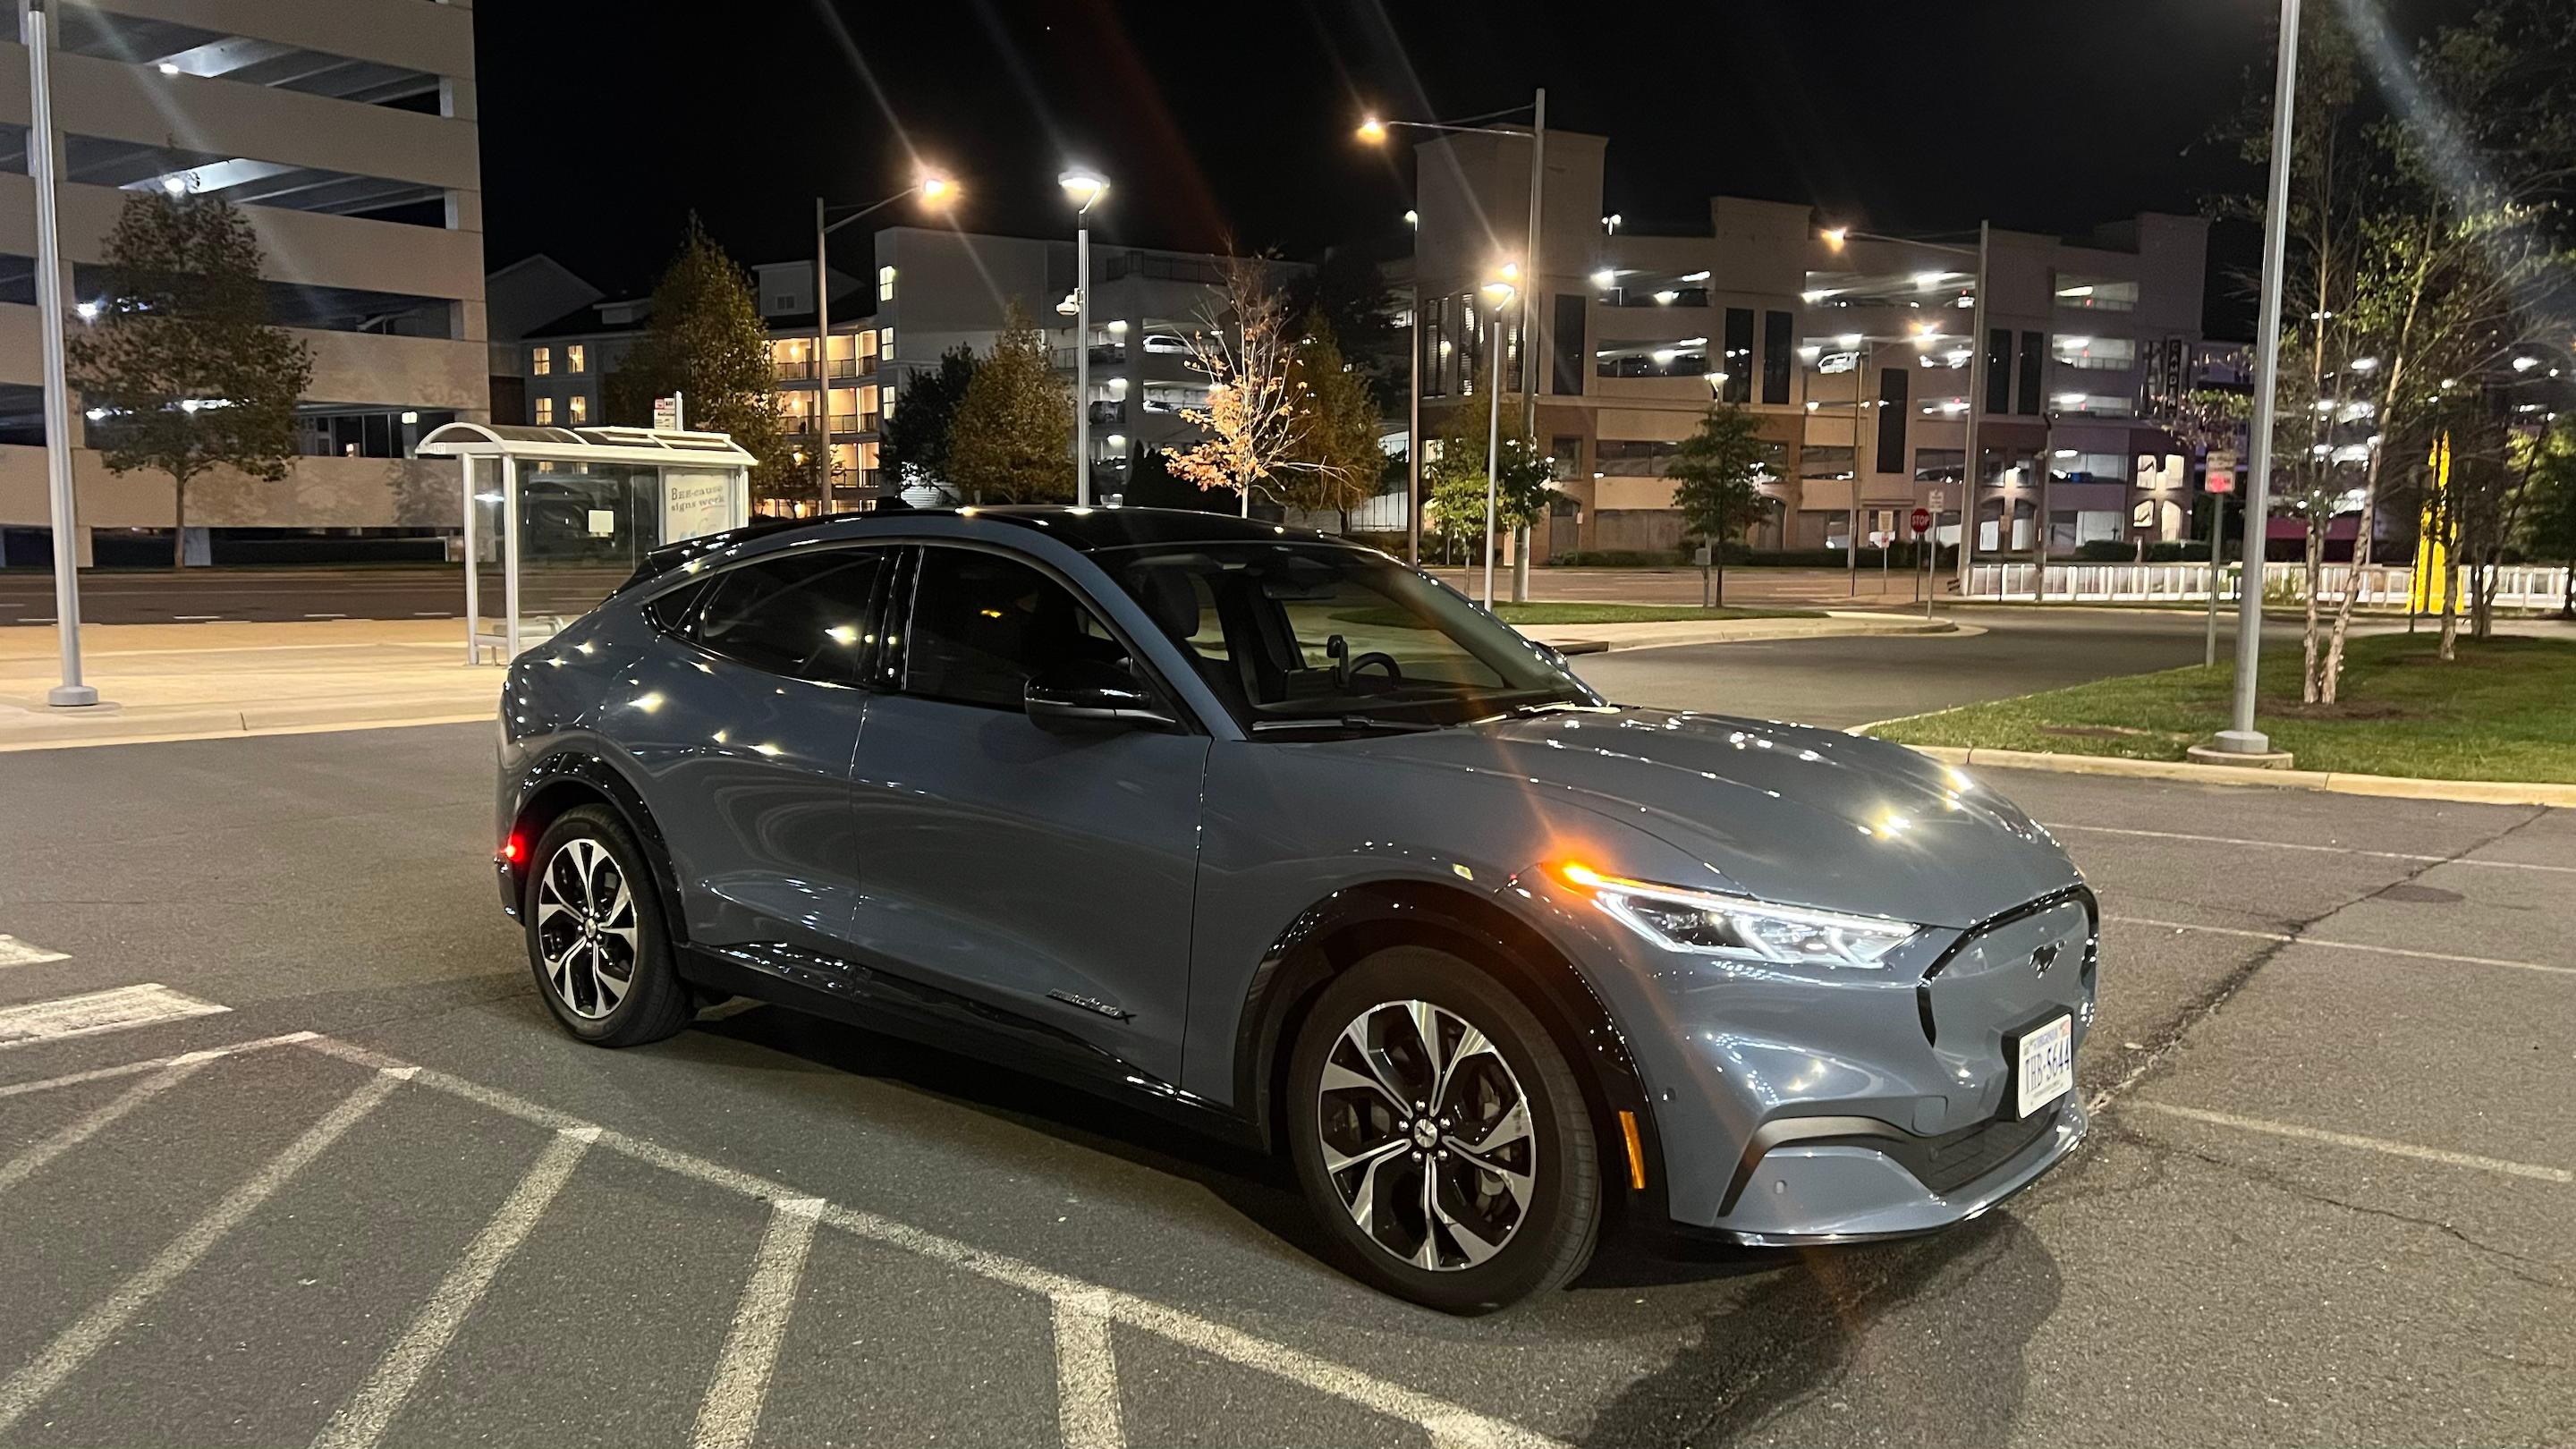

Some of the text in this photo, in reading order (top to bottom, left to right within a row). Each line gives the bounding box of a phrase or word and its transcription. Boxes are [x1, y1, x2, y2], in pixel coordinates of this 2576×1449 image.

[671, 495, 724, 513] signs work
[1911, 514, 1929, 526] STOP
